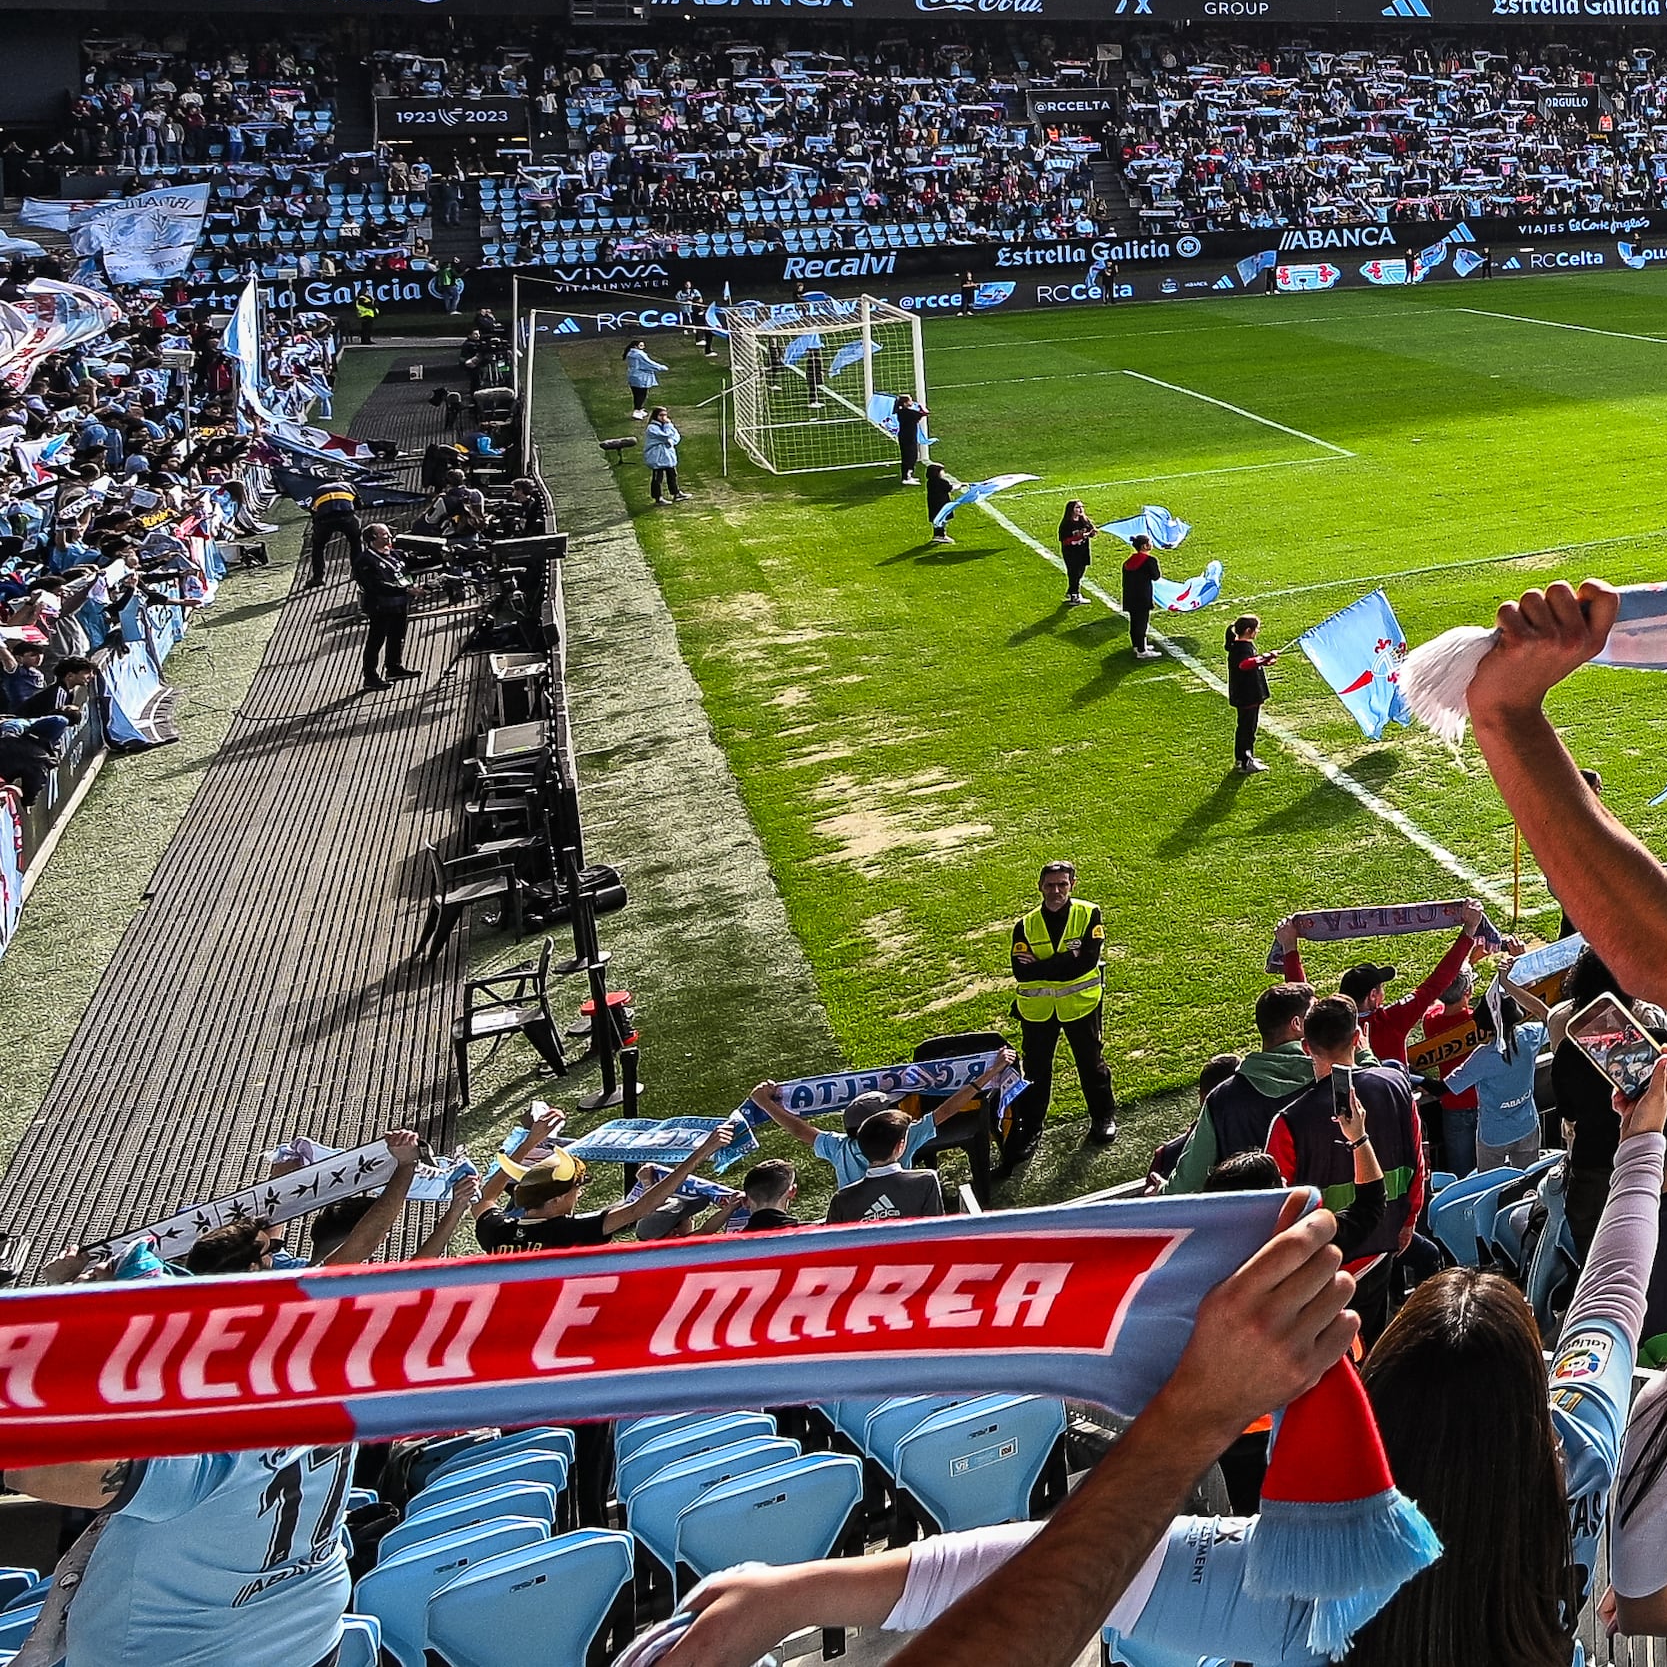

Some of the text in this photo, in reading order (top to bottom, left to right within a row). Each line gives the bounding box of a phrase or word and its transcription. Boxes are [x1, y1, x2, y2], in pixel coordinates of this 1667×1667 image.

[1204, 1, 1269, 16] GROUP
[396, 110, 509, 124] 1923 2023
[1034, 100, 1111, 114] @RCCELTA
[1518, 222, 1565, 235] VIAJES
[996, 240, 1171, 268] Estrella Galicia
[1530, 249, 1604, 269] RCCelta
[783, 251, 898, 280] Recalvi
[305, 278, 422, 309] Galicia
[555, 279, 669, 293] VITAMINWATER
[1037, 282, 1133, 303] RCCeta
[899, 290, 962, 310] @rcce
[531, 1276, 620, 1370] E
[647, 1261, 1074, 1359] MAREA
[257, 1441, 355, 1574] 17
